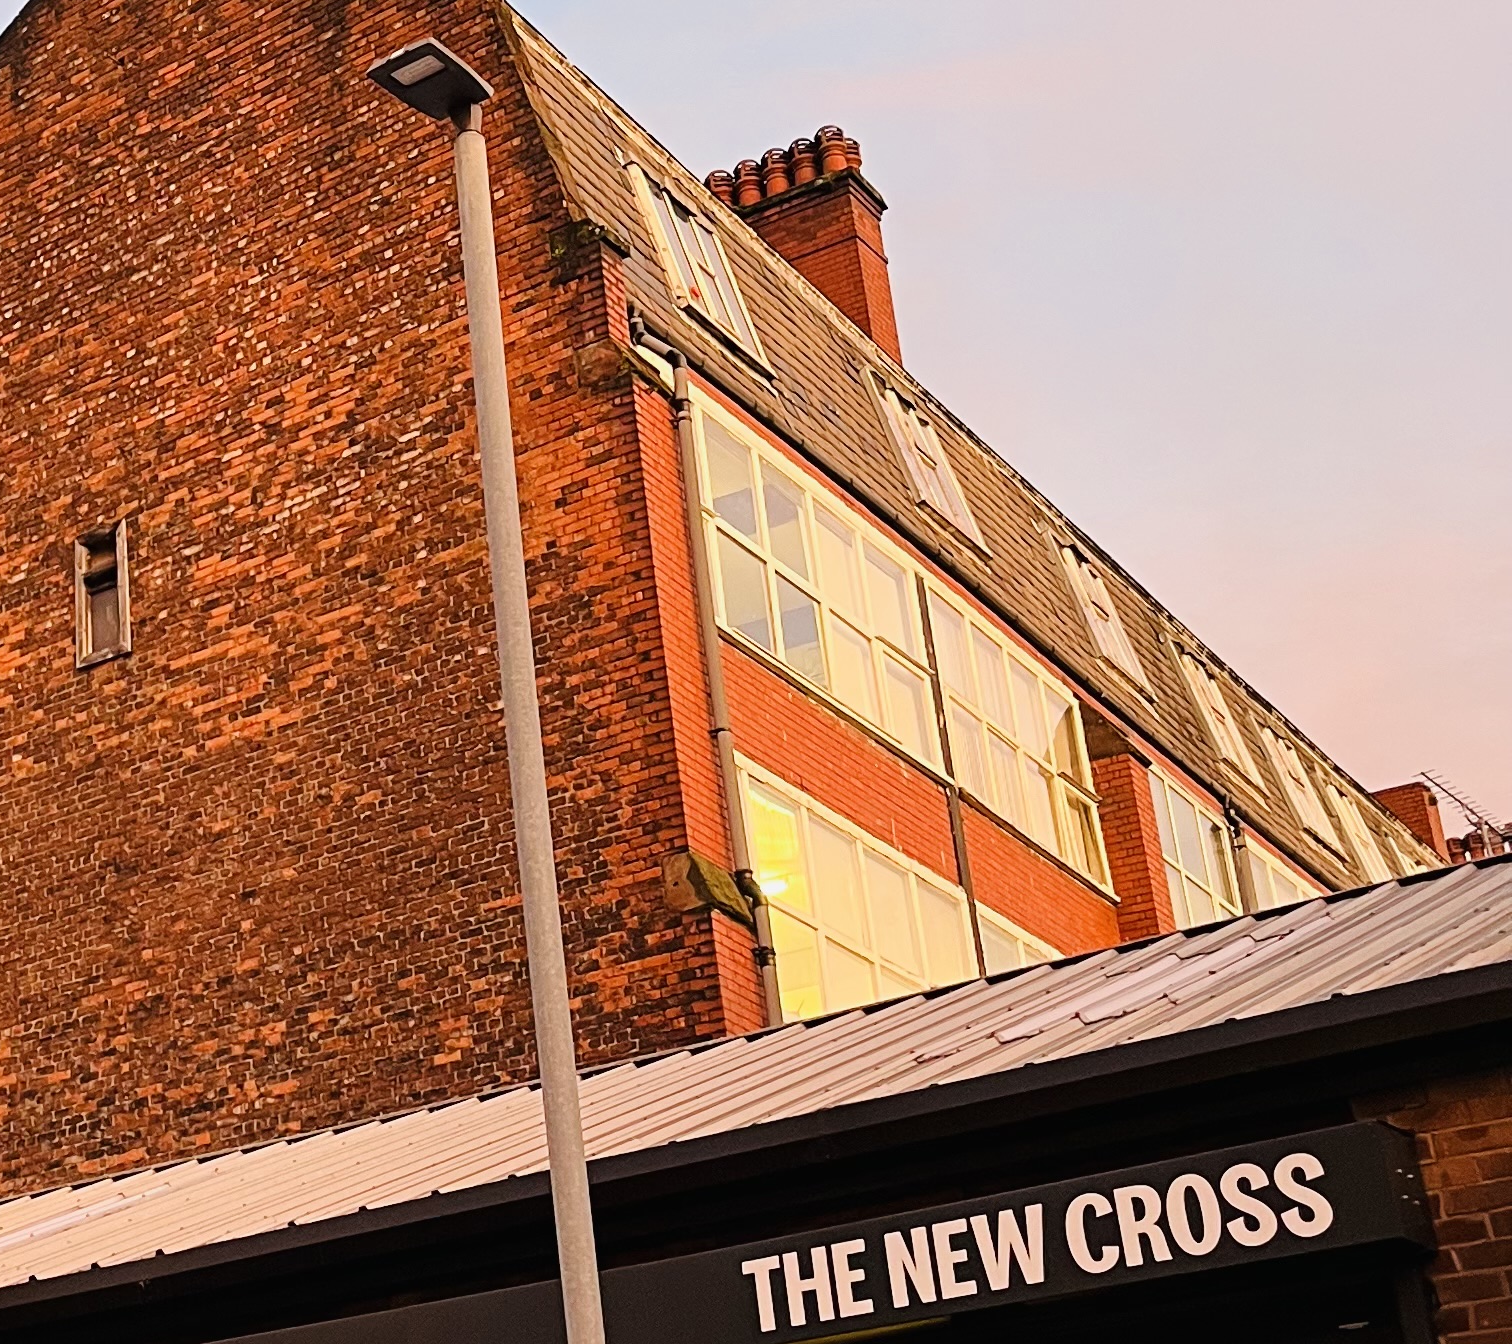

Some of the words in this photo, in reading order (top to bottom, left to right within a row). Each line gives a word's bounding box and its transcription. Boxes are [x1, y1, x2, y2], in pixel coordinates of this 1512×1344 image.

[742, 1239, 875, 1332] THE
[884, 1204, 1045, 1308] NEW
[1065, 1153, 1333, 1273] CROSS
